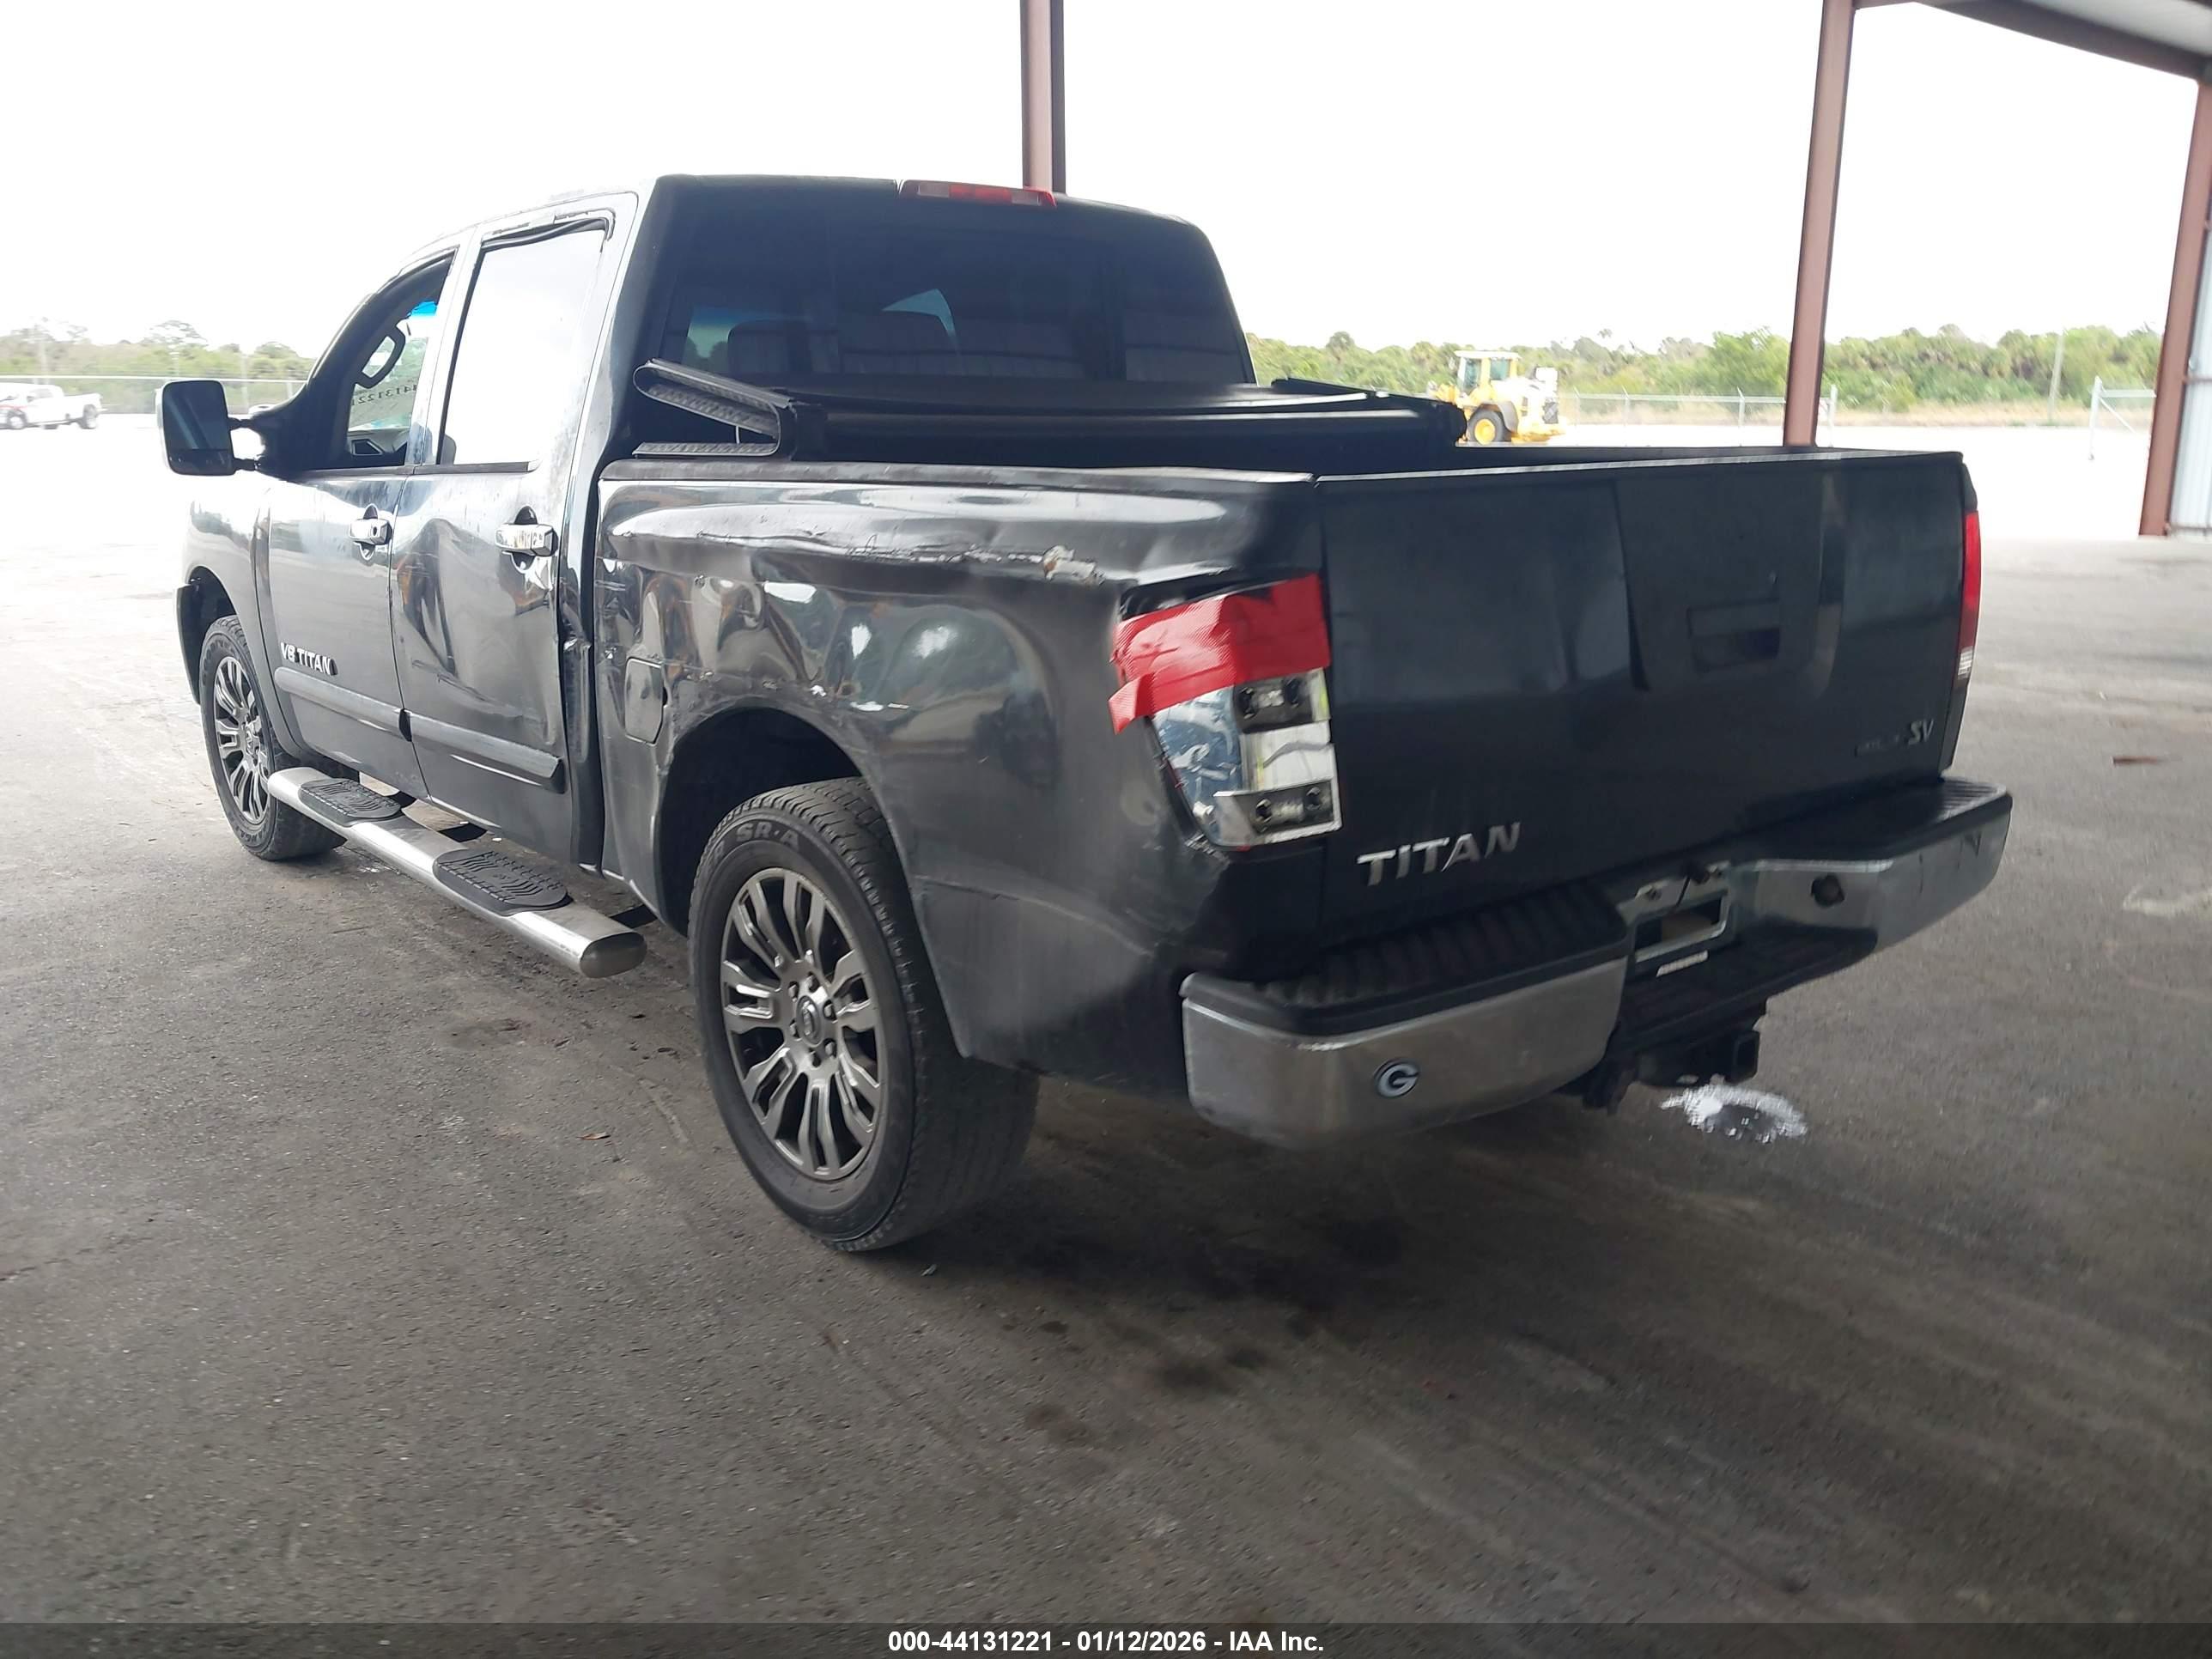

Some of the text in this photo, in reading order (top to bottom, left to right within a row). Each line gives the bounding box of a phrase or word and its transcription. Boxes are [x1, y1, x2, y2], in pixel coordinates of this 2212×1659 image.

[280, 642, 331, 676] V8 TITAN
[1908, 719, 1934, 745] SV
[1356, 821, 1521, 887] TITAN
[1376, 1062, 1419, 1098] G
